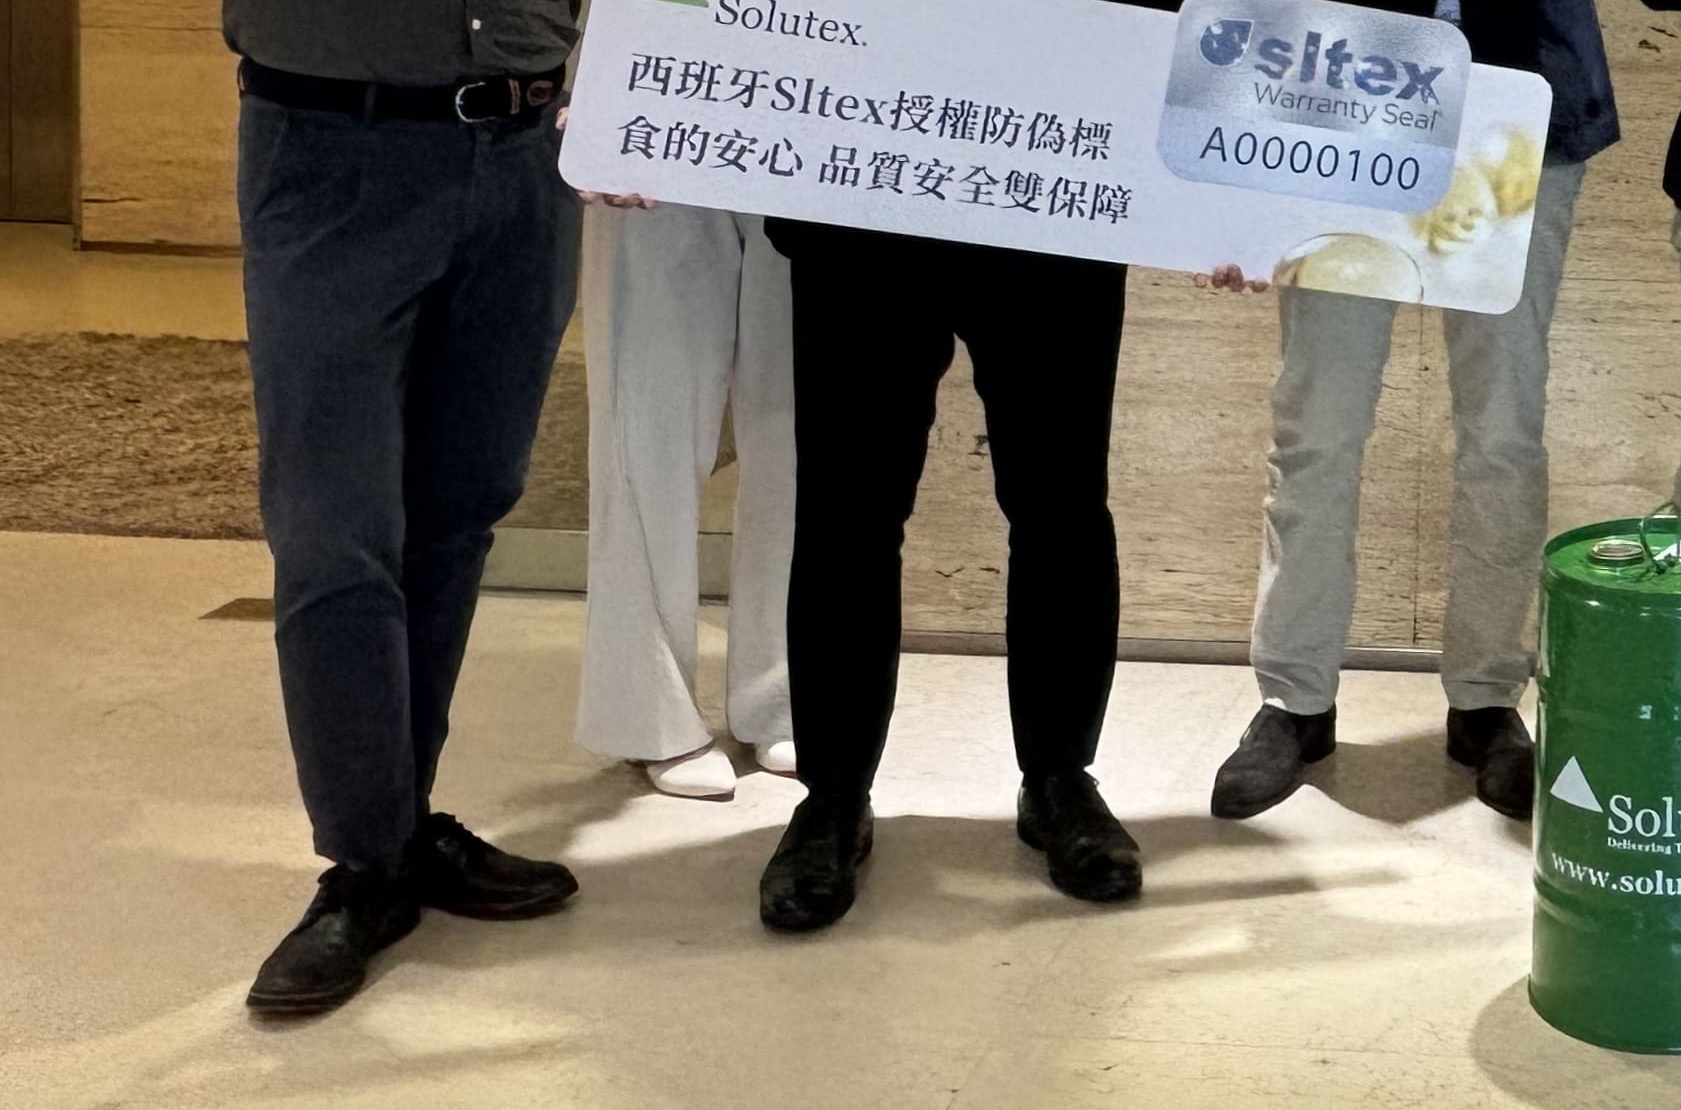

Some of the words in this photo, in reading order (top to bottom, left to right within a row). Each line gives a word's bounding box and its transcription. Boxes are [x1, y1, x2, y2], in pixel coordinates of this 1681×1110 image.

[627, 51, 1115, 162] 西班牙Sltex授權防偽標
[1254, 81, 1377, 126] Warranty
[1382, 102, 1441, 132] Seal
[616, 113, 805, 179] 食的安心
[817, 145, 1134, 226] 品質安全雙保障
[1200, 125, 1421, 191] A0000100
